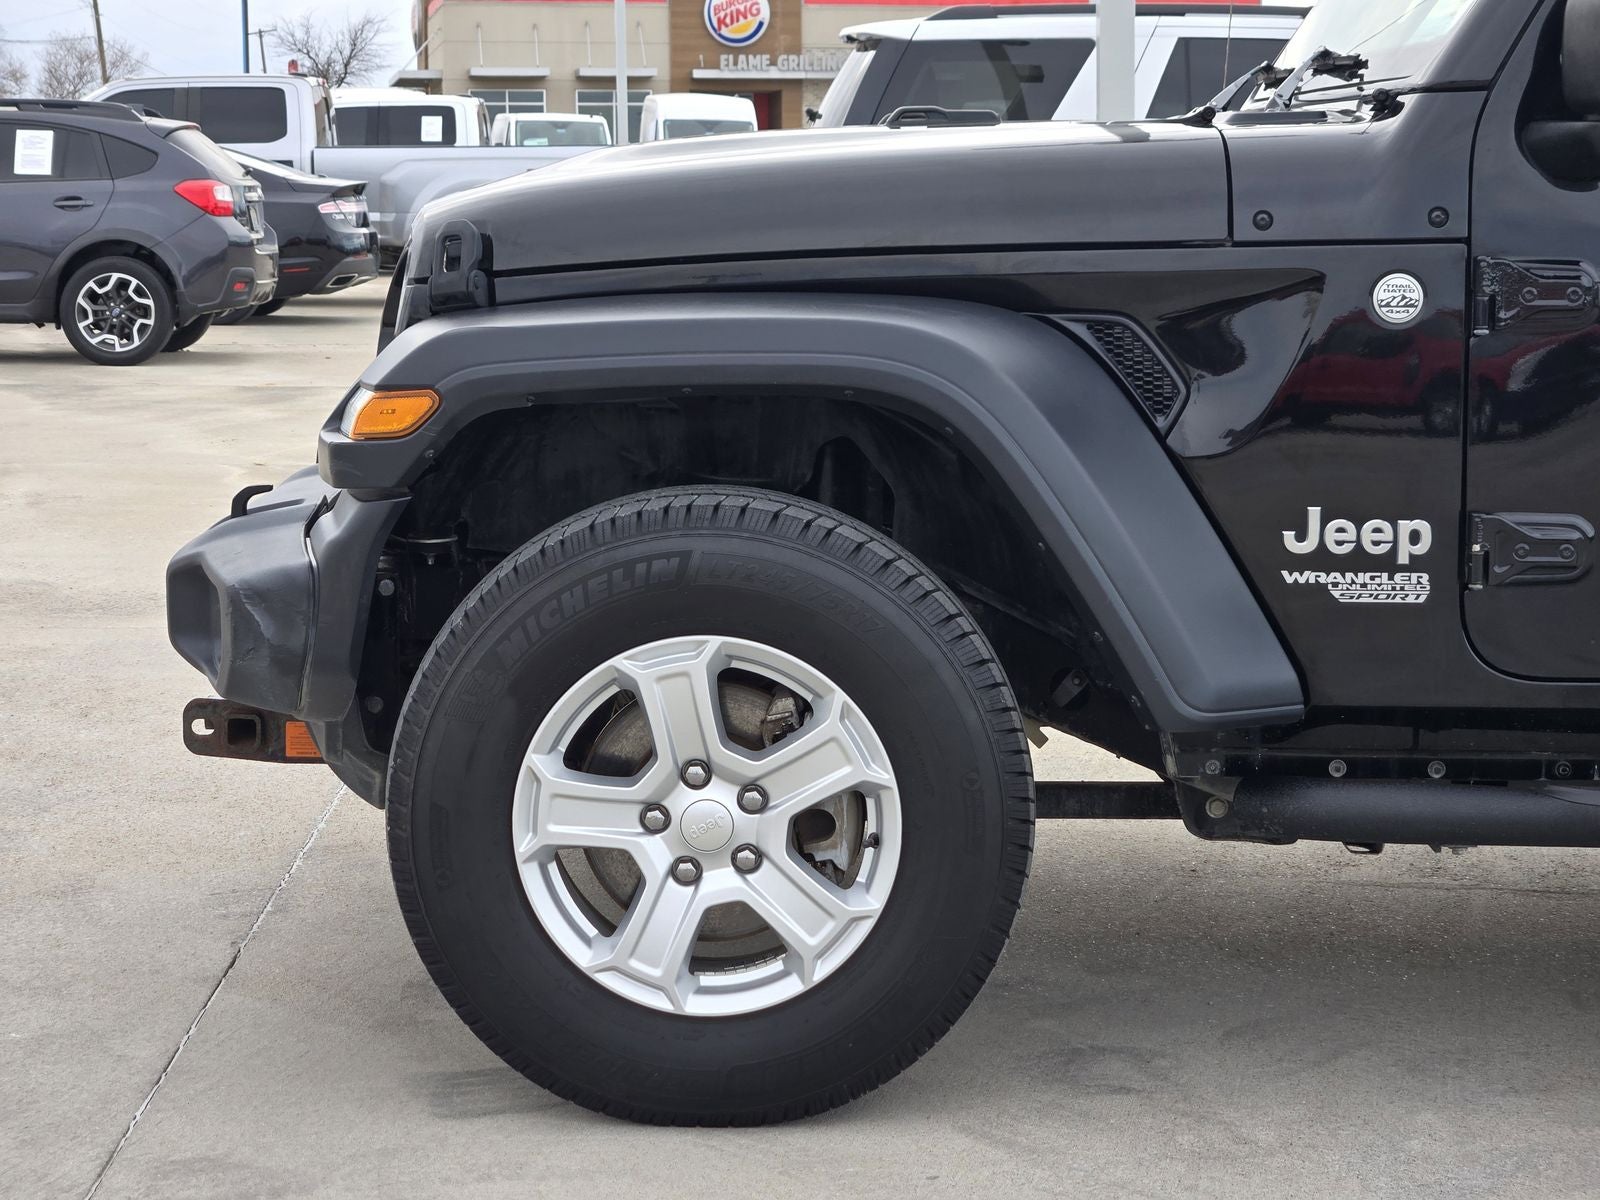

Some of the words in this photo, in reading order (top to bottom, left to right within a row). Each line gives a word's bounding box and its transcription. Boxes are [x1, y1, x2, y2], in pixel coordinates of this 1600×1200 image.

[716, 1, 761, 32] KING
[720, 54, 770, 71] FLAME
[1281, 506, 1433, 564] Jeep
[1280, 570, 1430, 584] WRANGLER
[1327, 583, 1431, 591] UNLIMITED
[1337, 592, 1425, 601] SPORT
[499, 556, 681, 662] MICHELIN
[689, 811, 726, 839] Jeep
